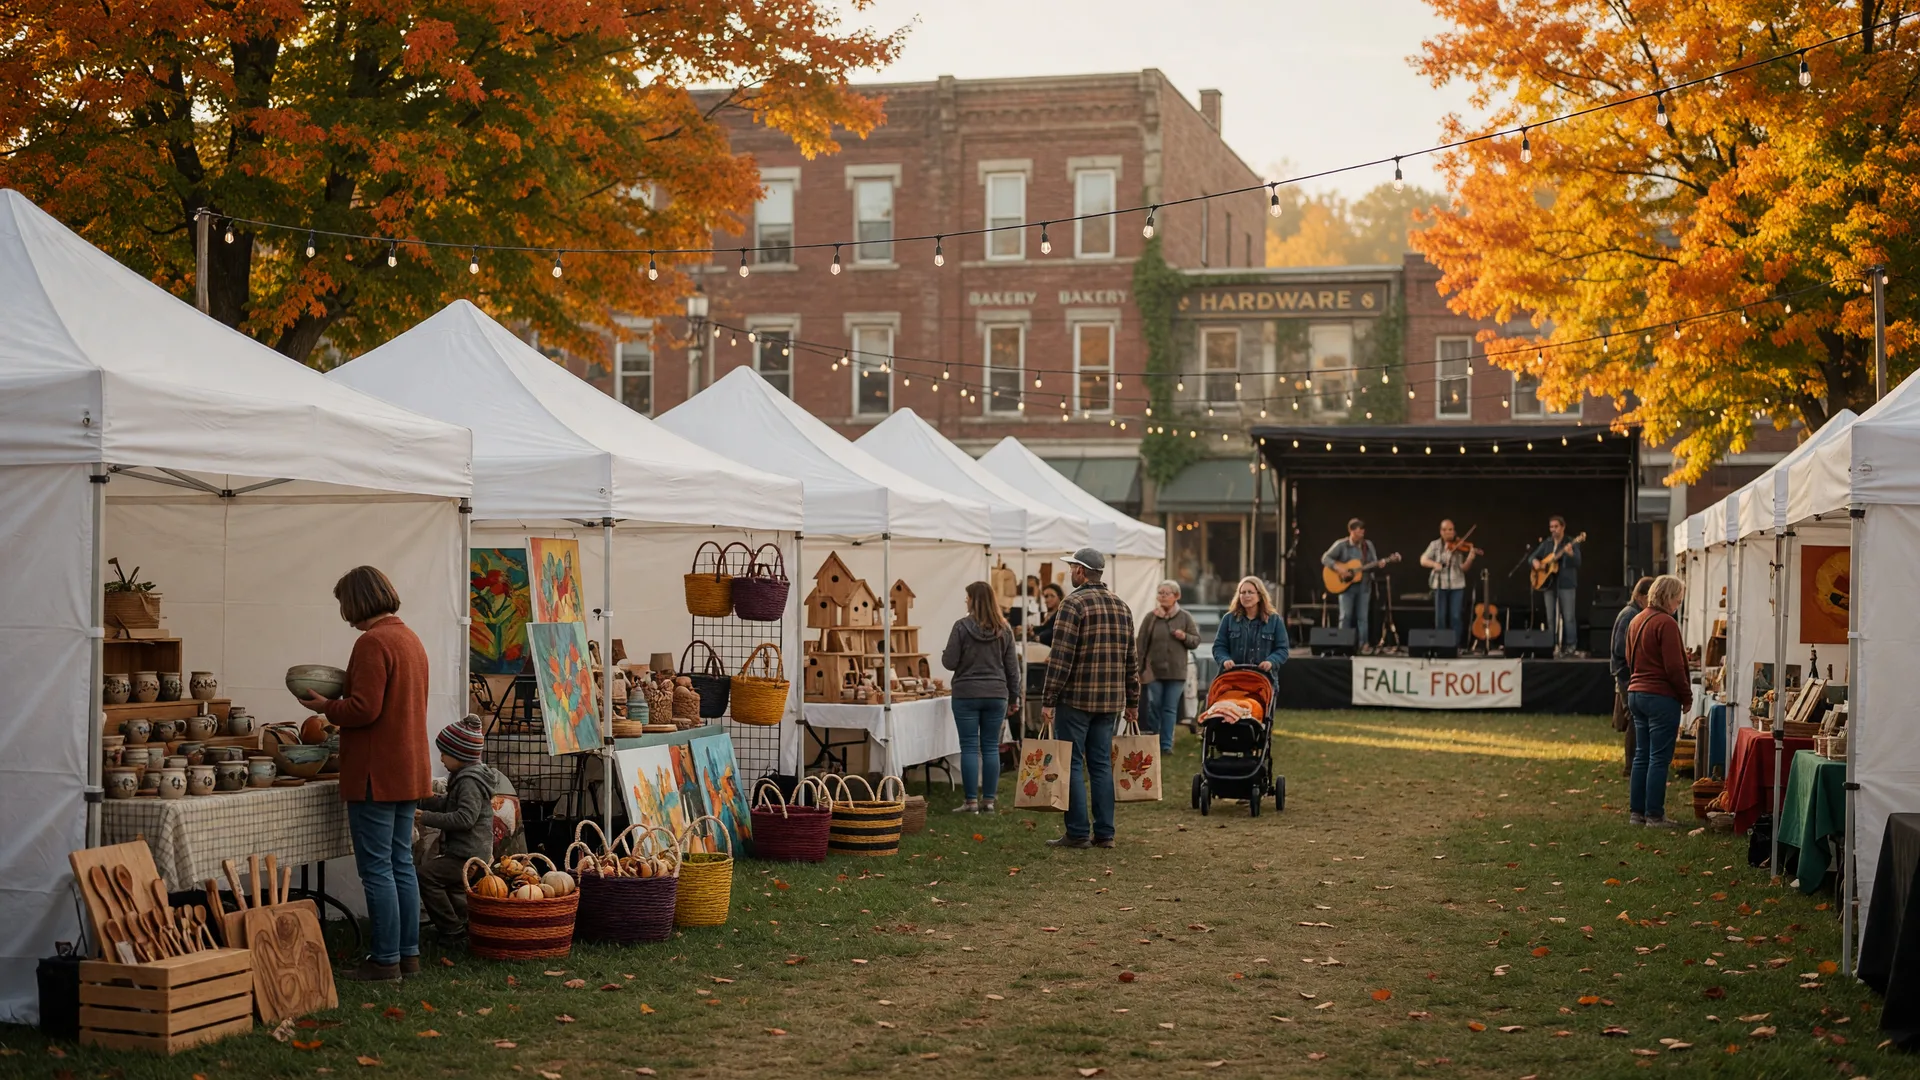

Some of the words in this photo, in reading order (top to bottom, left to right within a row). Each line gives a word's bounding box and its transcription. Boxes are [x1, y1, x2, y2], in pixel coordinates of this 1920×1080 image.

[969, 291, 1037, 306] BAKERY
[1059, 290, 1127, 305] BAKERY
[1200, 290, 1352, 311] HARDWARE
[1363, 667, 1419, 695] FALL
[1430, 670, 1513, 697] FROLIC
